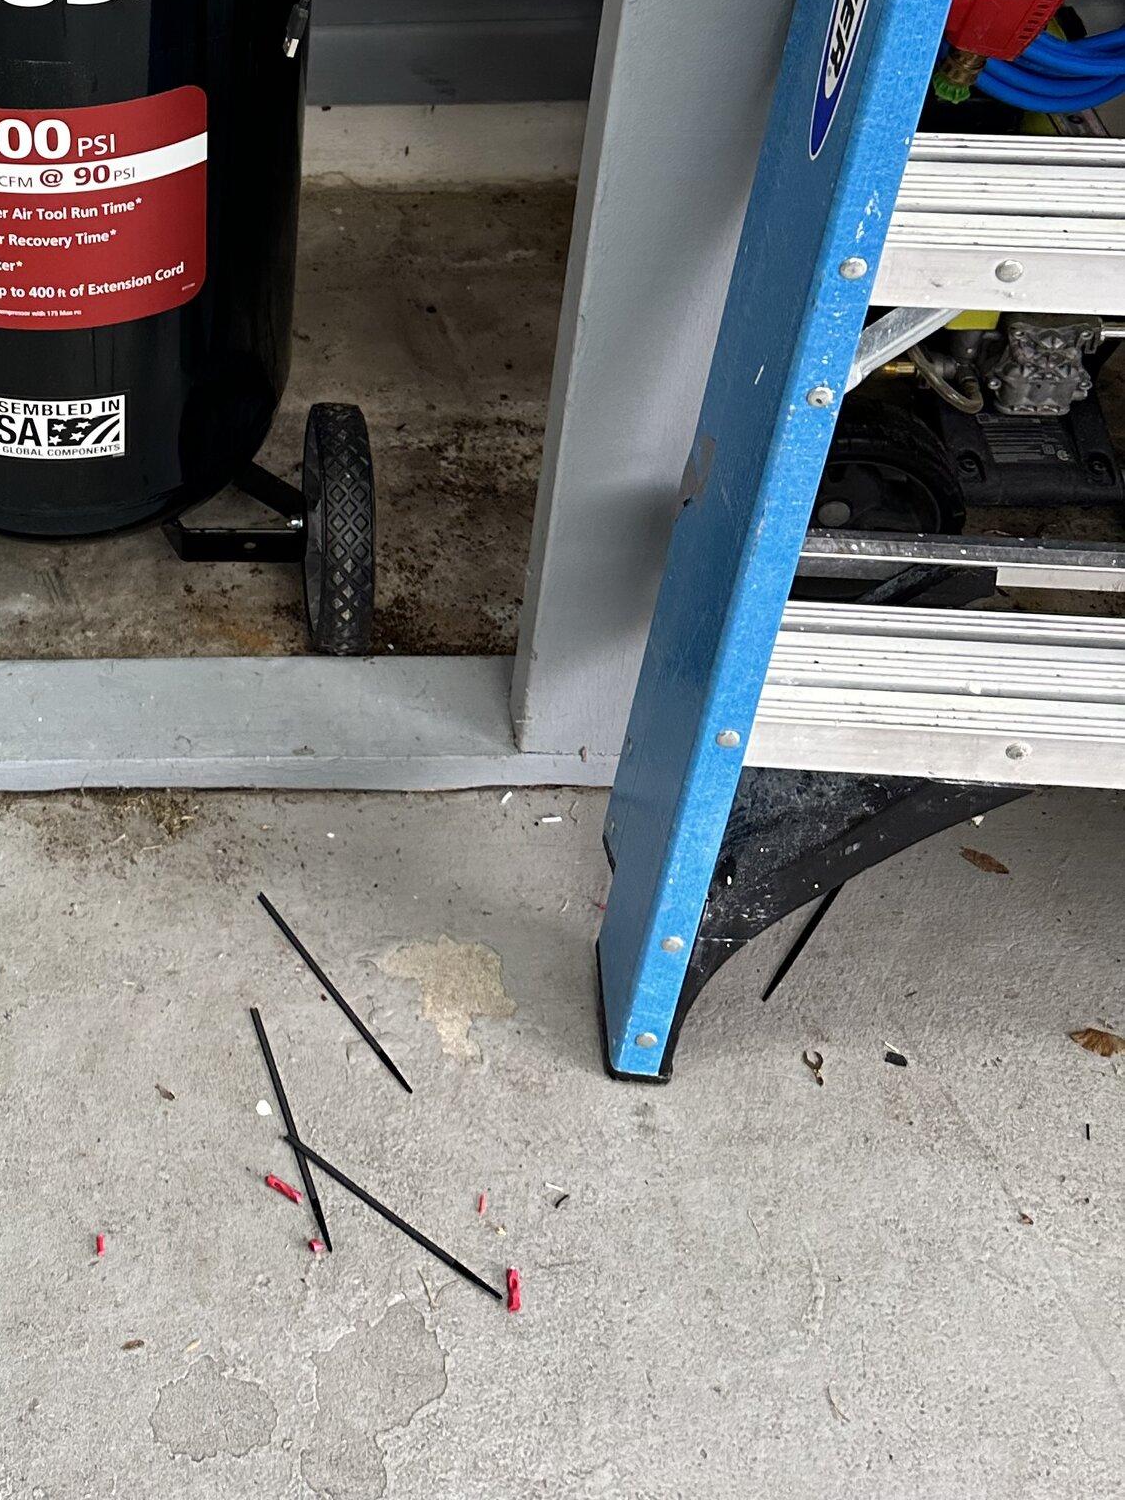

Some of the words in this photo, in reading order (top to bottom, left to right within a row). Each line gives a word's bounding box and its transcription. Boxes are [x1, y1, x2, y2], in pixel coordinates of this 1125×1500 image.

[77, 134, 116, 157] PSI
[39, 168, 64, 188] @
[74, 165, 111, 185] 90
[113, 167, 136, 182] PSI
[12, 206, 33, 220] Air
[36, 206, 67, 220] Tool
[71, 205, 98, 219] Run
[8, 233, 72, 249] Recovery
[10, 285, 25, 298] to
[28, 286, 55, 299] 400
[57, 287, 67, 298] ft
[69, 282, 85, 298] of
[88, 273, 152, 296] Extension
[155, 262, 185, 283] Cord
[101, 399, 120, 413] IN
[3, 445, 44, 457] GLOBAL
[47, 443, 120, 457] COMPONENTS
